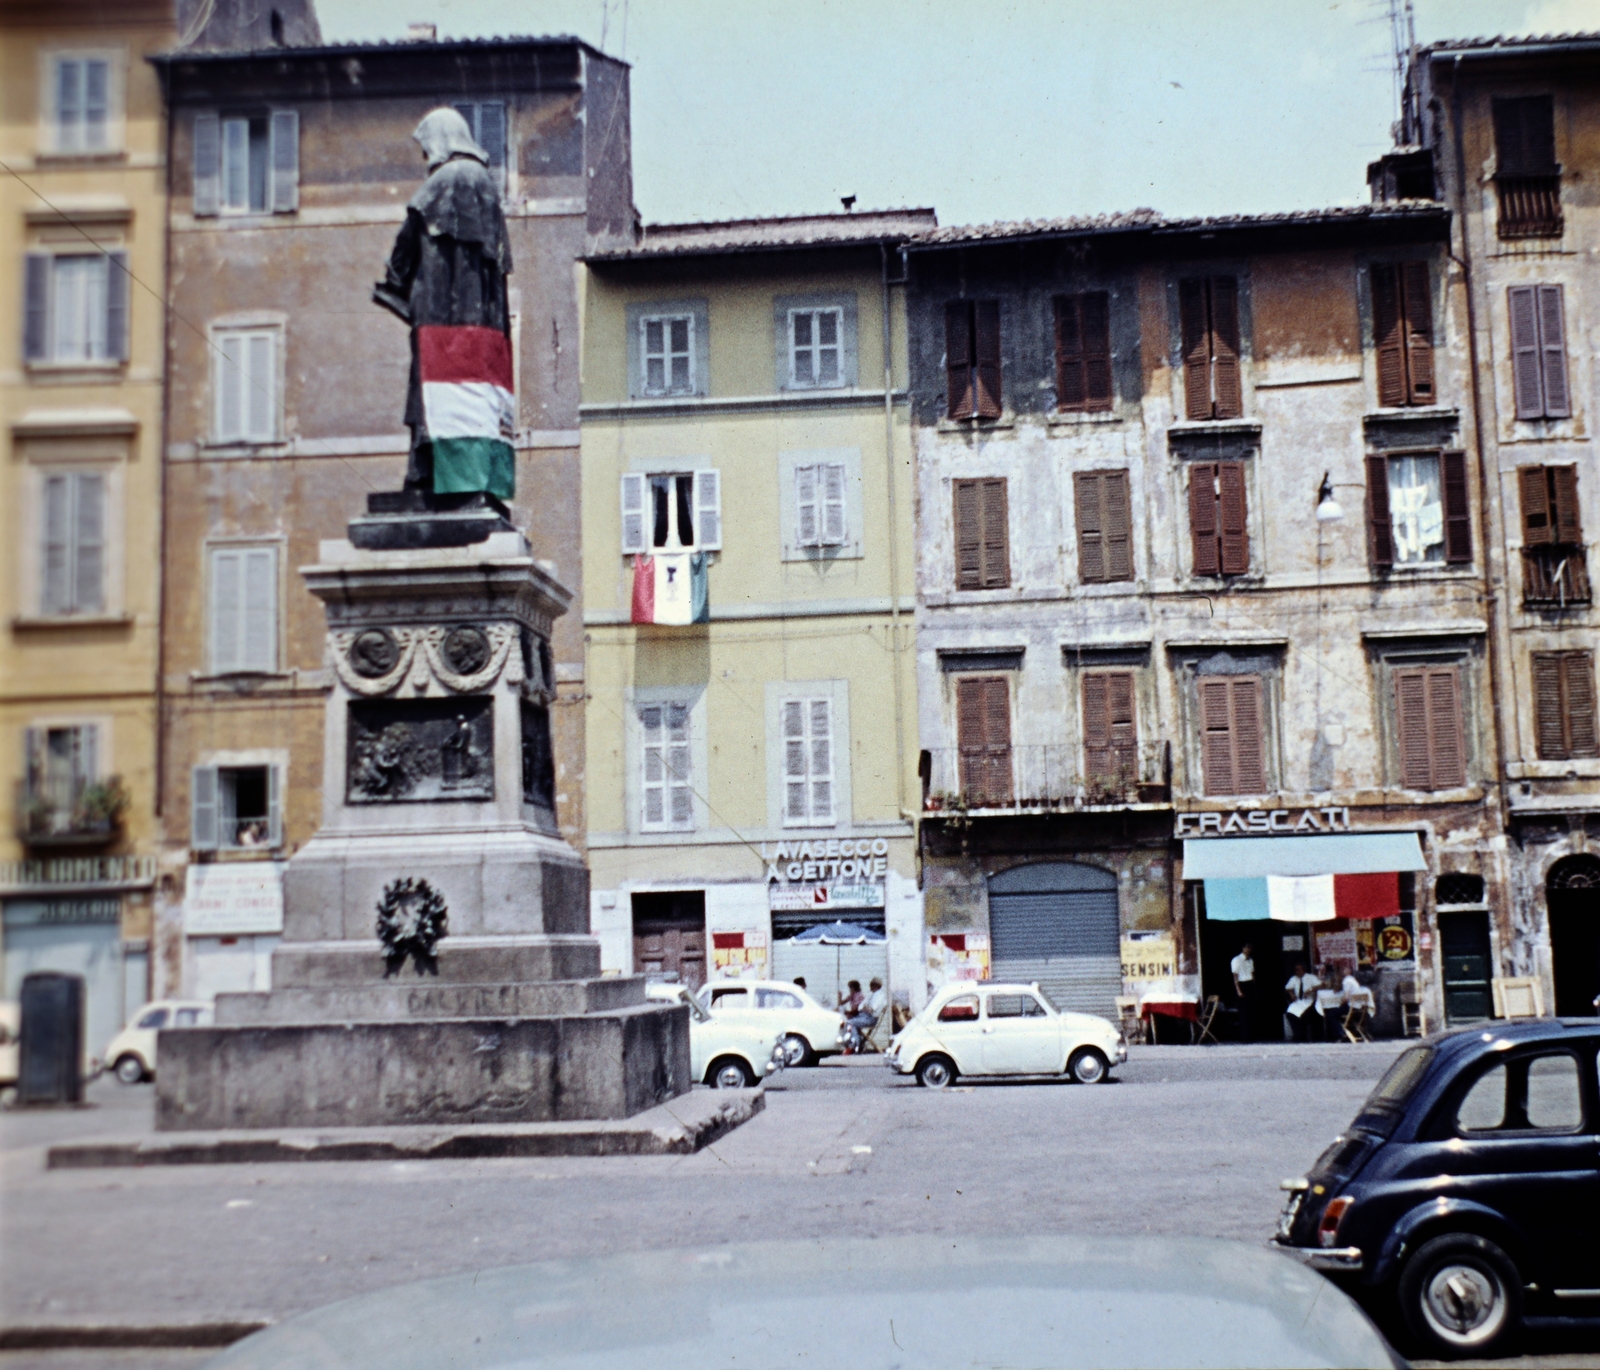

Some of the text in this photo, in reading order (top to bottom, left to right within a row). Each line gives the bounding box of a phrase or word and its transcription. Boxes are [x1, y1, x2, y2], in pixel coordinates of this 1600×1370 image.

[1177, 807, 1349, 833] FRASCATI
[761, 838, 888, 859] LAVASECCO
[766, 858, 887, 881] A GETTONE
